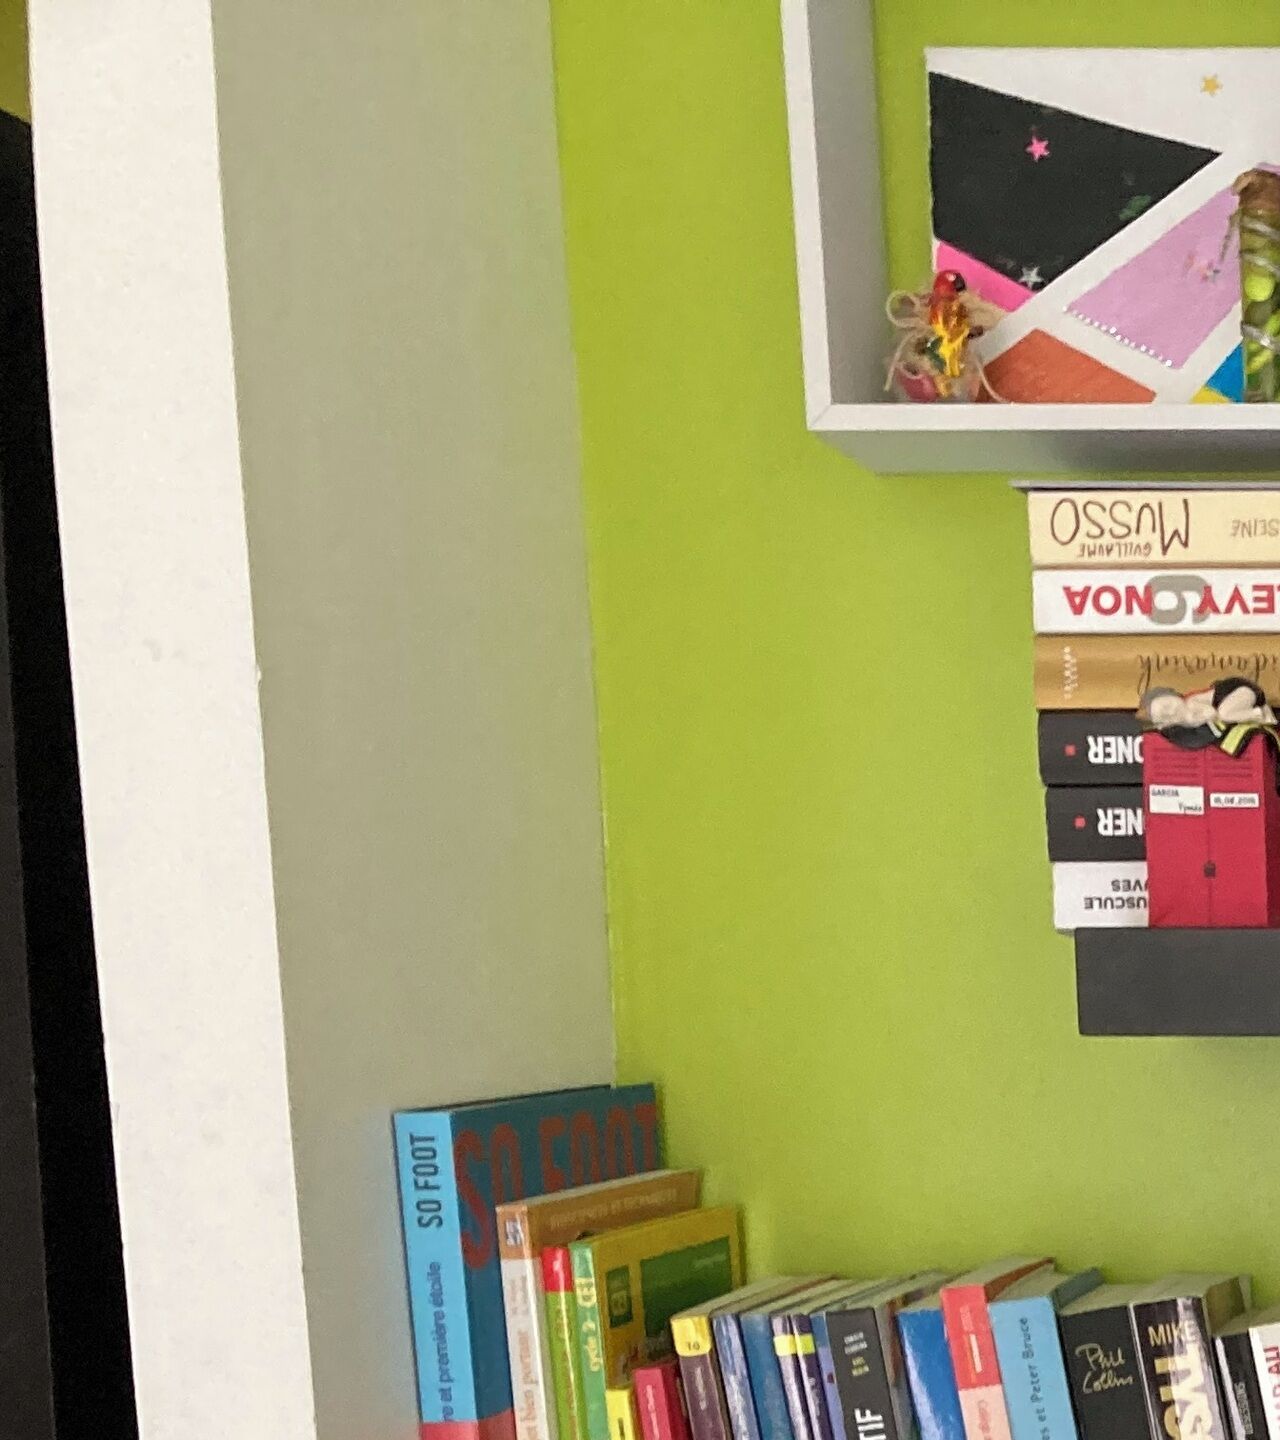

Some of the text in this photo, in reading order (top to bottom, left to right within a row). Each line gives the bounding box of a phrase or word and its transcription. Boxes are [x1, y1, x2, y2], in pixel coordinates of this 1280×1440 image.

[1050, 499, 1190, 556] MUSSO
[1231, 518, 1279, 537] SEINE
[1063, 586, 1152, 616] NOA
[409, 1133, 443, 1228] SO FOOT
[1149, 1321, 1199, 1347] MIKE
